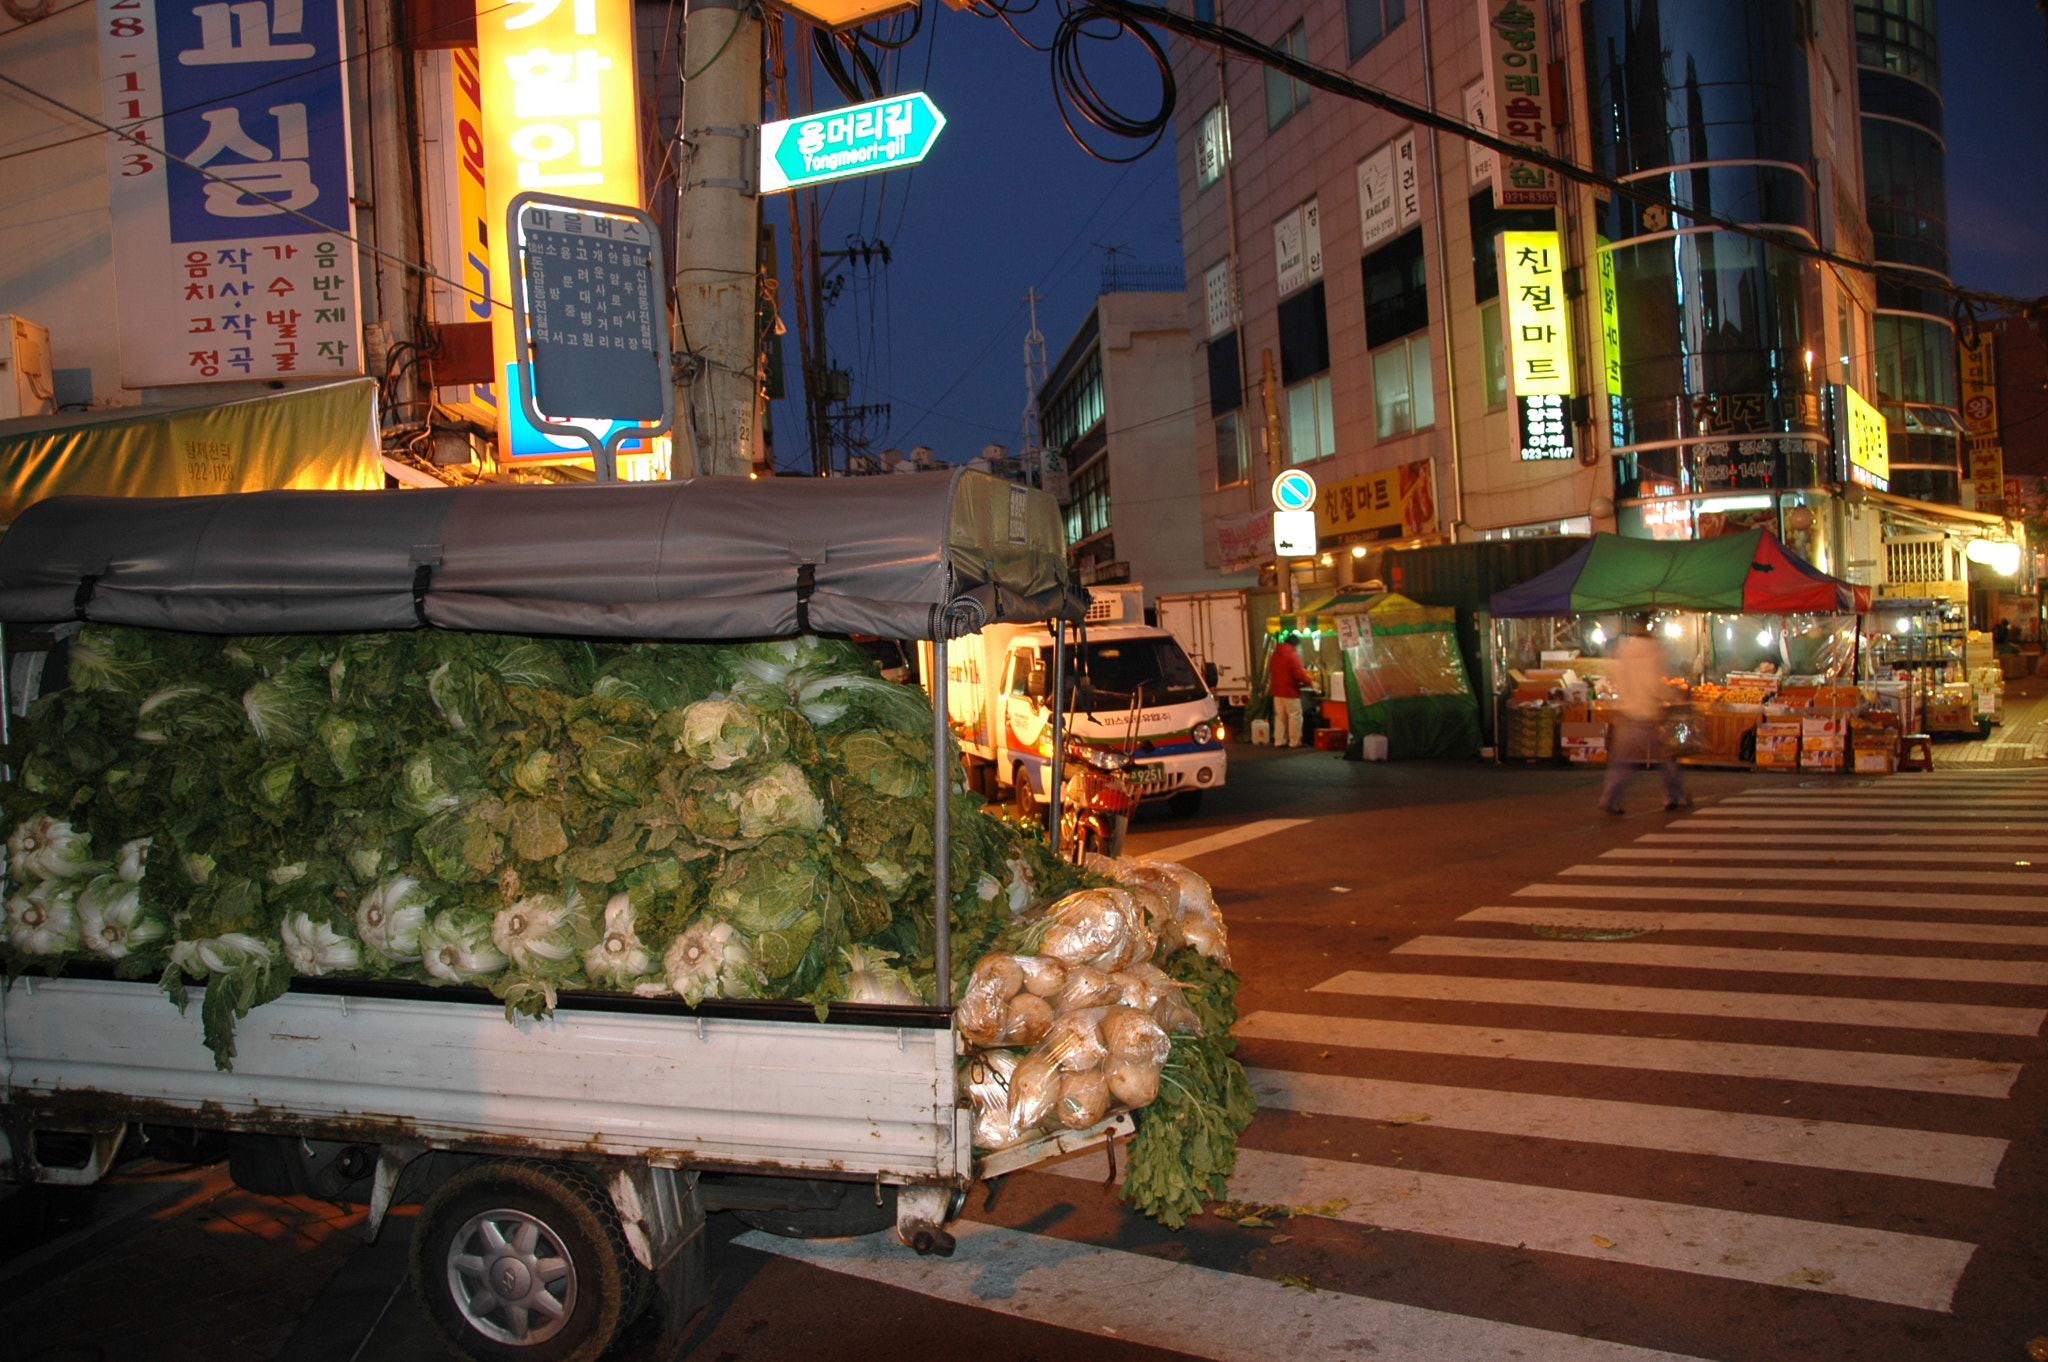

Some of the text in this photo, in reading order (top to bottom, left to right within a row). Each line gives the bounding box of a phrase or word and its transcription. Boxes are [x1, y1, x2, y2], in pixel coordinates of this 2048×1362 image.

[797, 101, 912, 154] 용머리길
[1401, 141, 1417, 218] 태권도
[531, 209, 640, 242] 마을버스
[576, 248, 594, 347] 고려대병원
[608, 251, 625, 350] 안암로타리
[1517, 246, 1559, 380] 친절마트
[1521, 447, 1573, 460] 923-1497
[1324, 480, 1390, 524] 친절마트
